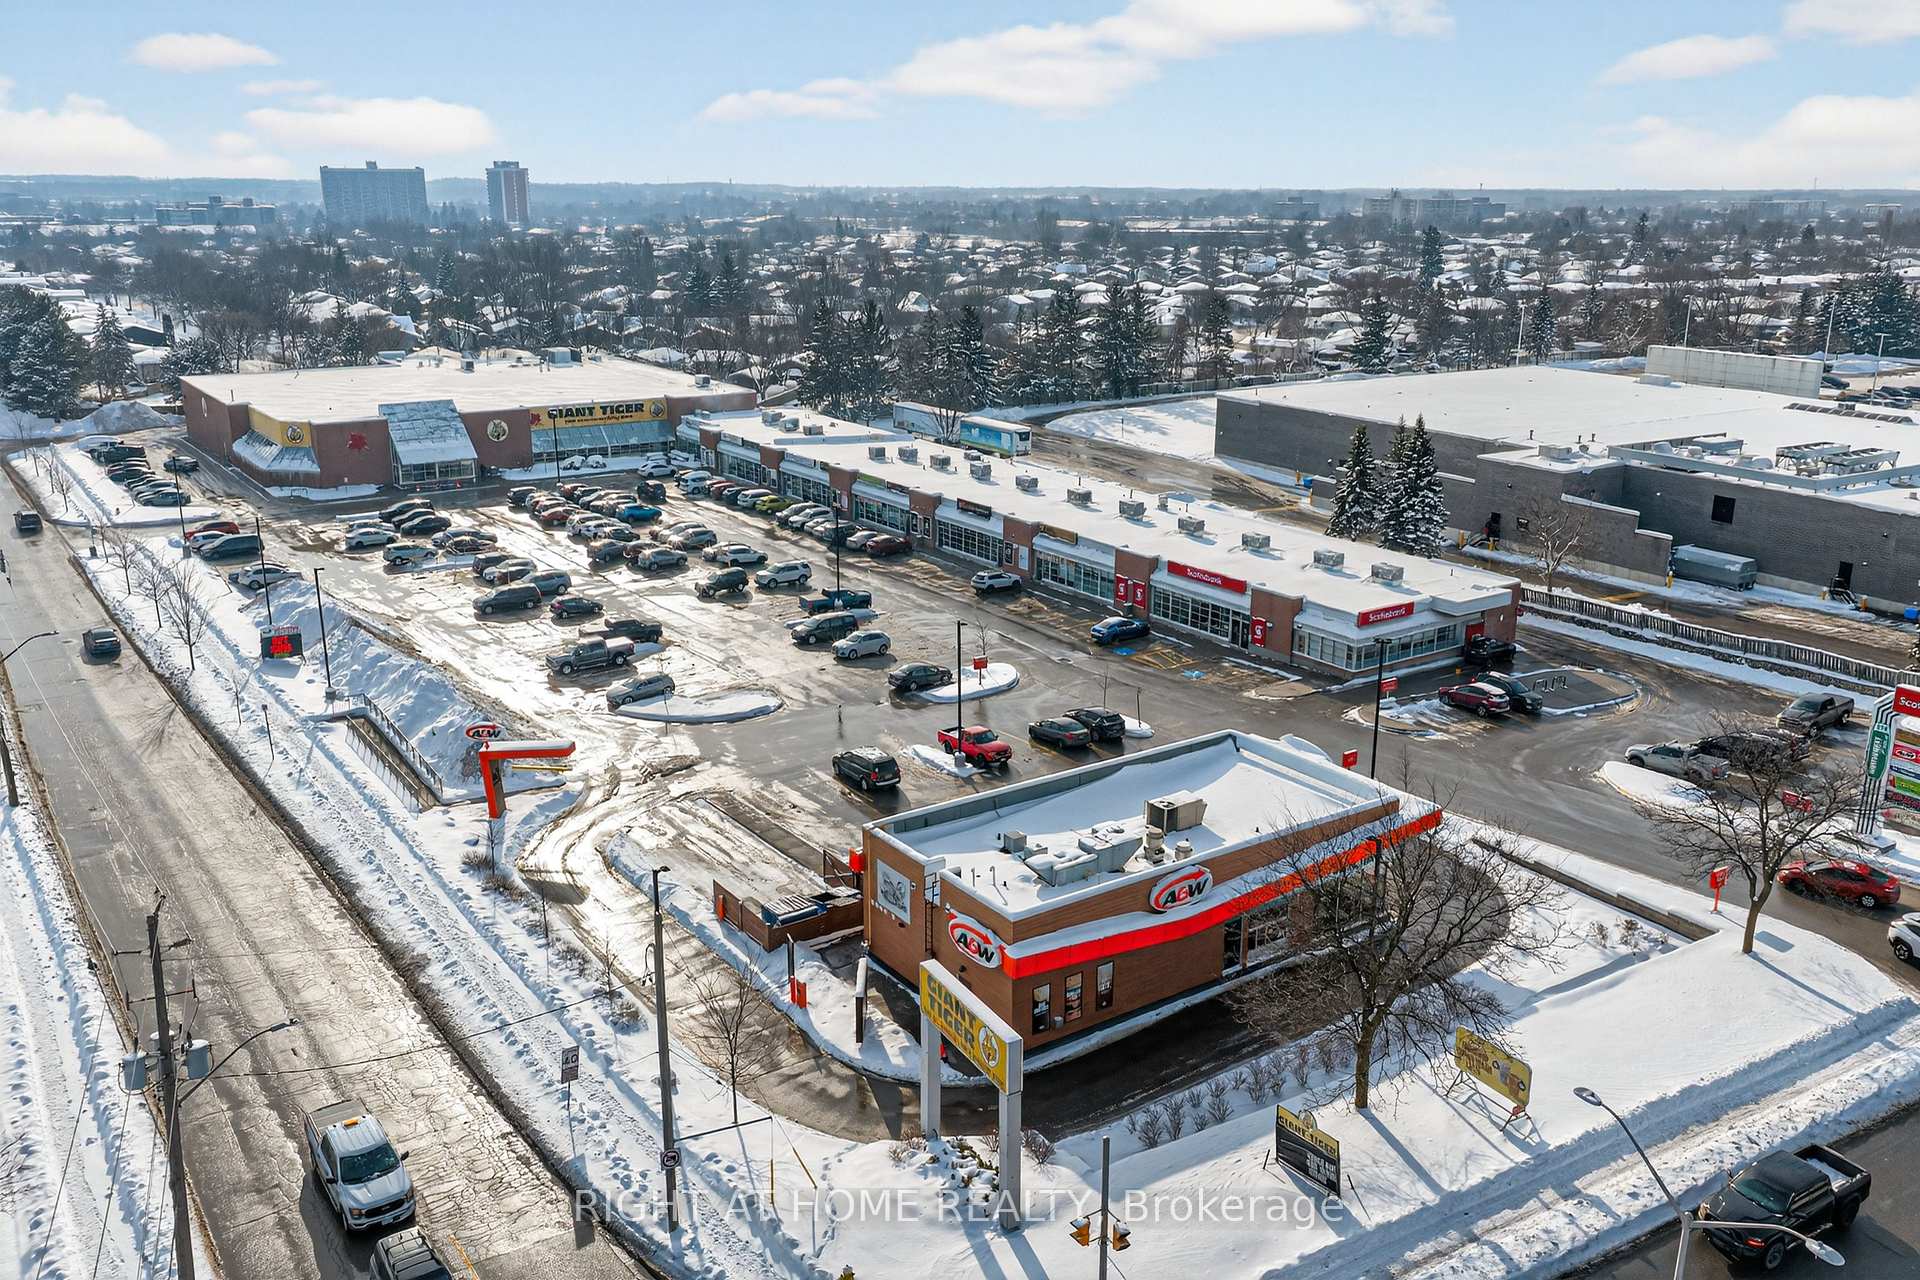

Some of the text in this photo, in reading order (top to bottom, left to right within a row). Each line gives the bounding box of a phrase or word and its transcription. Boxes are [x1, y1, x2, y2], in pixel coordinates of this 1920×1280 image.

[547, 403, 645, 419] GIANT TIGER
[1161, 875, 1210, 907] A&W
[956, 932, 995, 964] A&W
[926, 974, 977, 1030] GIANT
[928, 993, 976, 1053] TIGER
